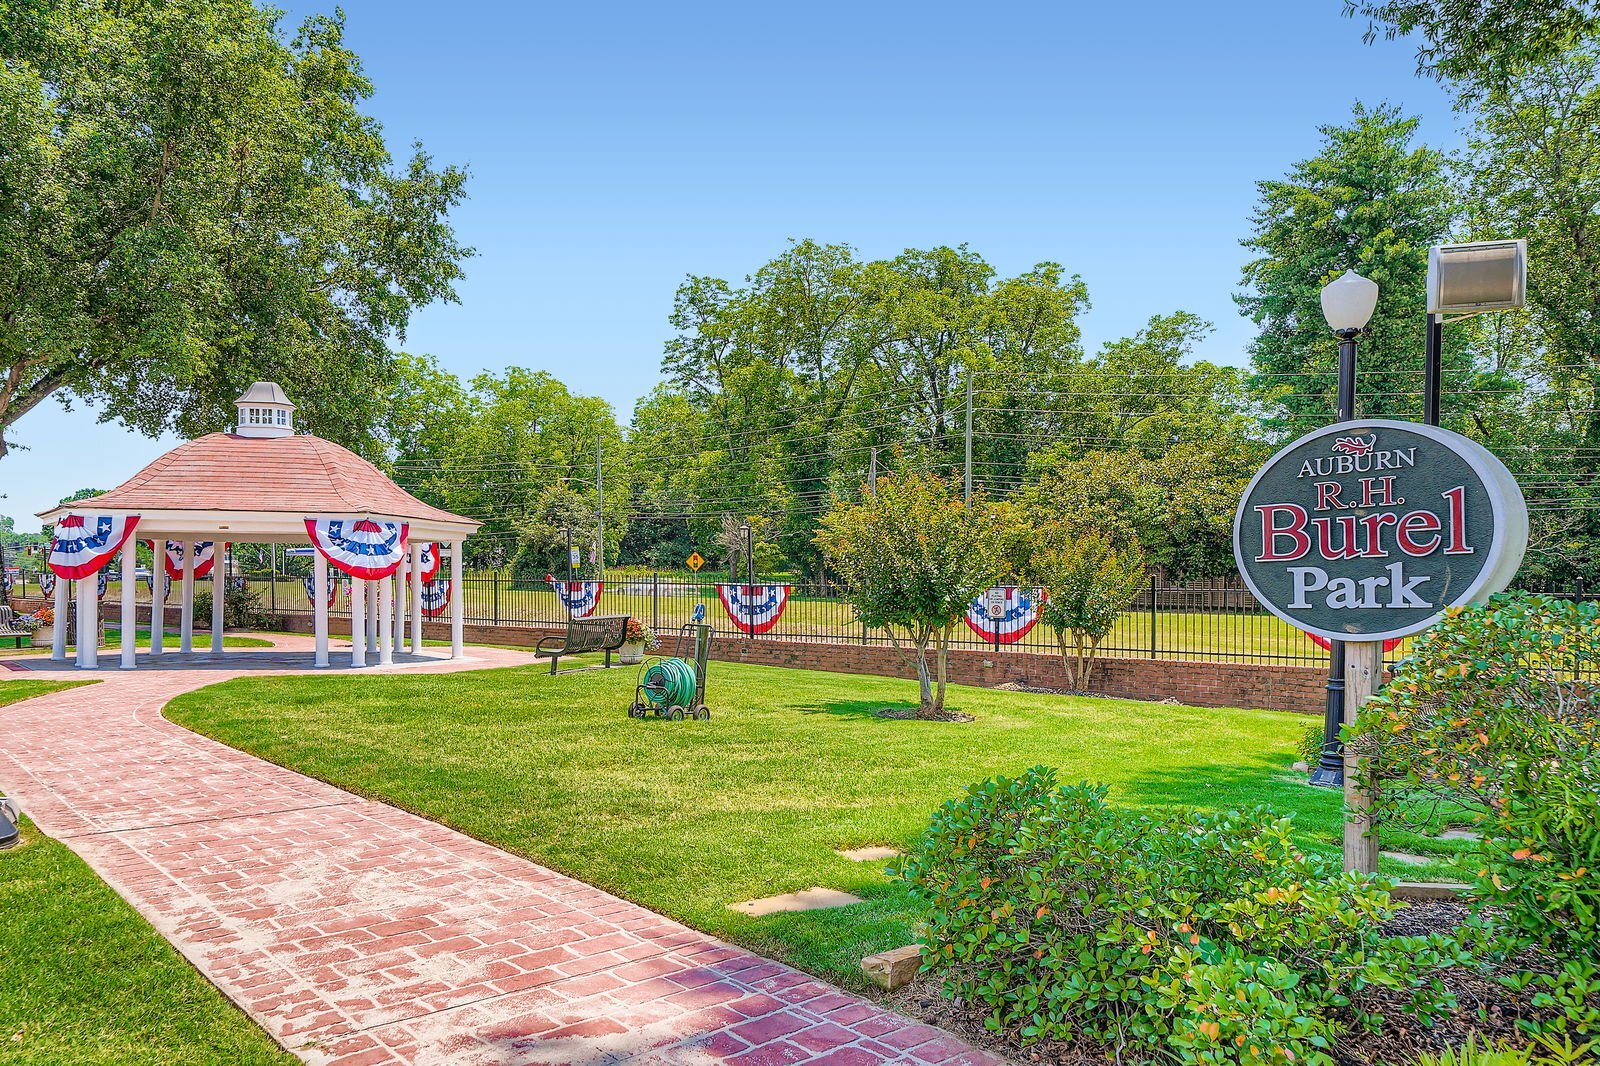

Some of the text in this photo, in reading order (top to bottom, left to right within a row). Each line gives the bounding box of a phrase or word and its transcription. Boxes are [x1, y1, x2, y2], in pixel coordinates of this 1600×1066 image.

[1297, 448, 1417, 478] AUBURN
[1313, 476, 1405, 511] R.H.
[1254, 485, 1474, 562] Burel
[1286, 561, 1433, 609] Park
